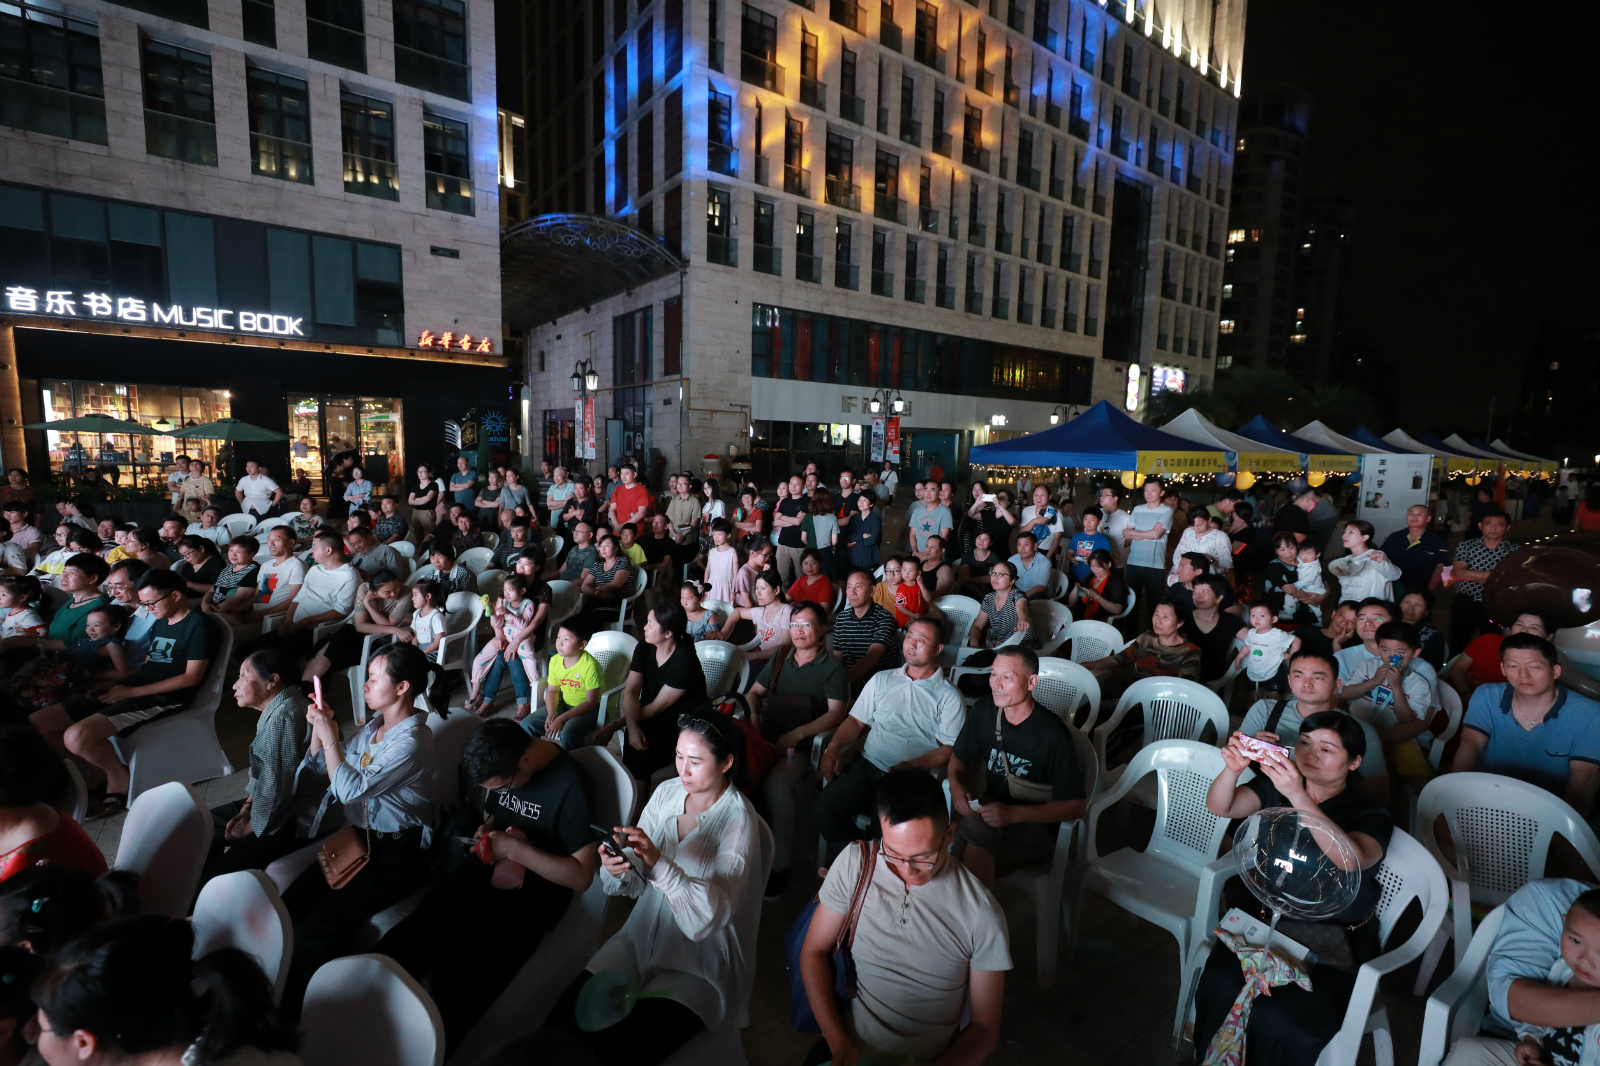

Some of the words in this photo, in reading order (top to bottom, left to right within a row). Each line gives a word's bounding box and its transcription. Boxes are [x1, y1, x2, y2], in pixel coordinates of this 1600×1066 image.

[5, 286, 147, 321] 音乐书店
[153, 302, 234, 329] MUSIC
[239, 311, 304, 335] BOOK
[498, 790, 542, 820] EASINESS
